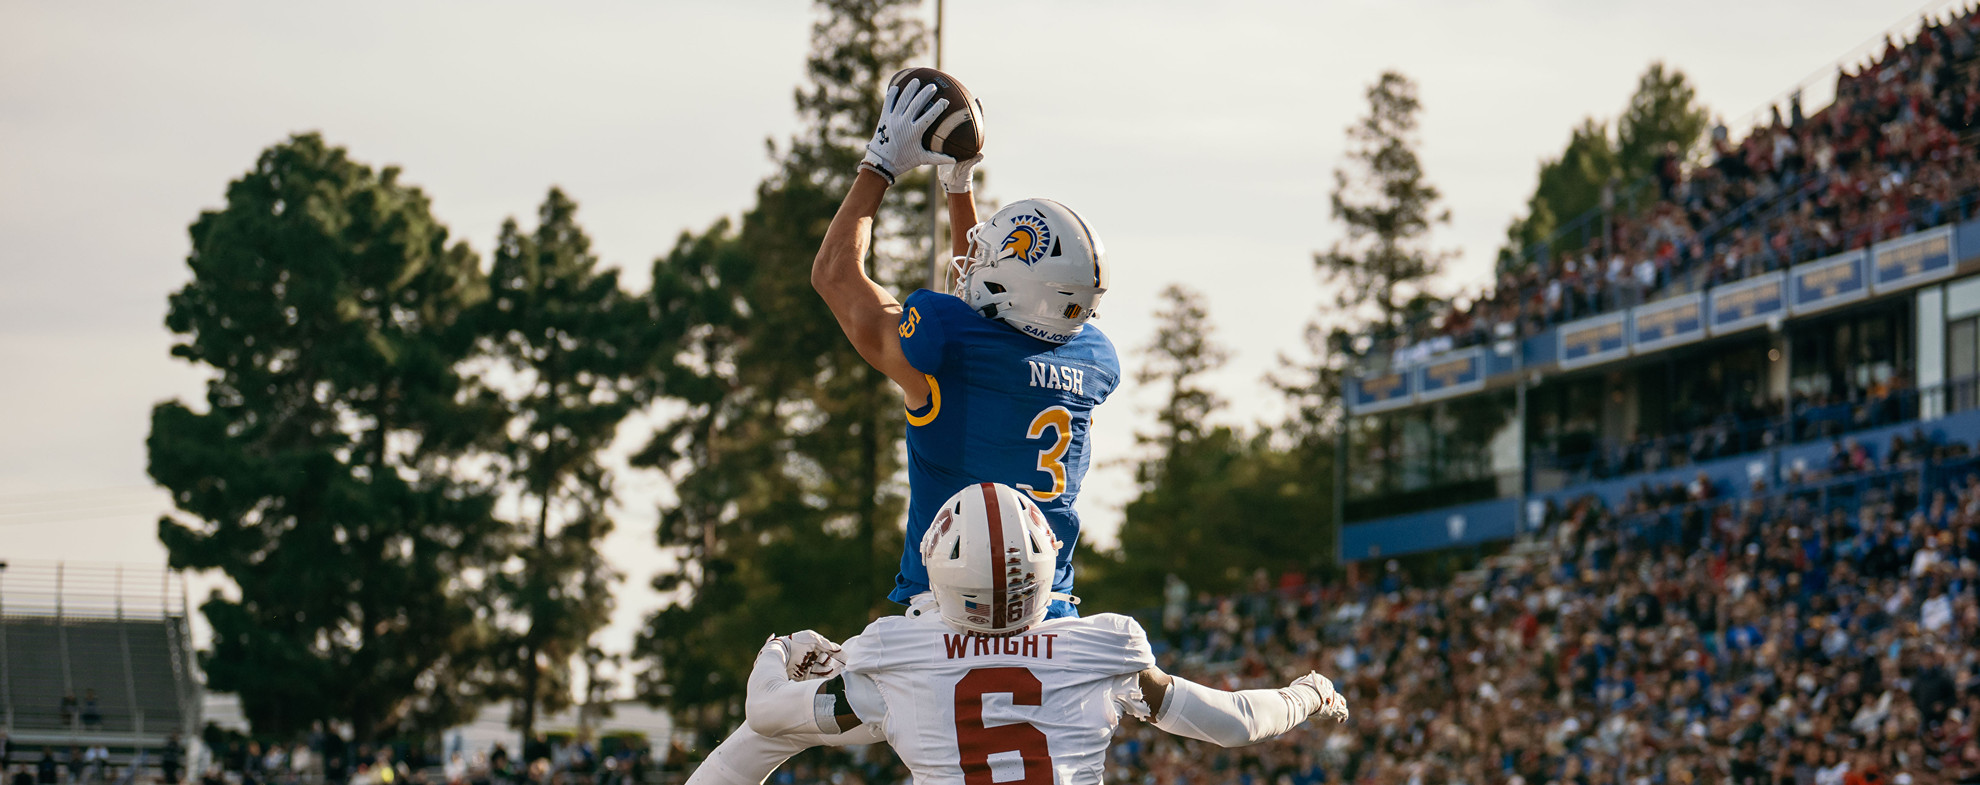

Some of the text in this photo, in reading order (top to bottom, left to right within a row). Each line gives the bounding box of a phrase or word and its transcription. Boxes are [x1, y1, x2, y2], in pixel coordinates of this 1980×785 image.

[1023, 325, 1048, 338] SAN
[1029, 361, 1084, 396] NASH
[1016, 405, 1073, 502] 3
[1007, 601, 1023, 623] 6
[943, 634, 1058, 659] WRIGHT
[954, 667, 1055, 785] 6
